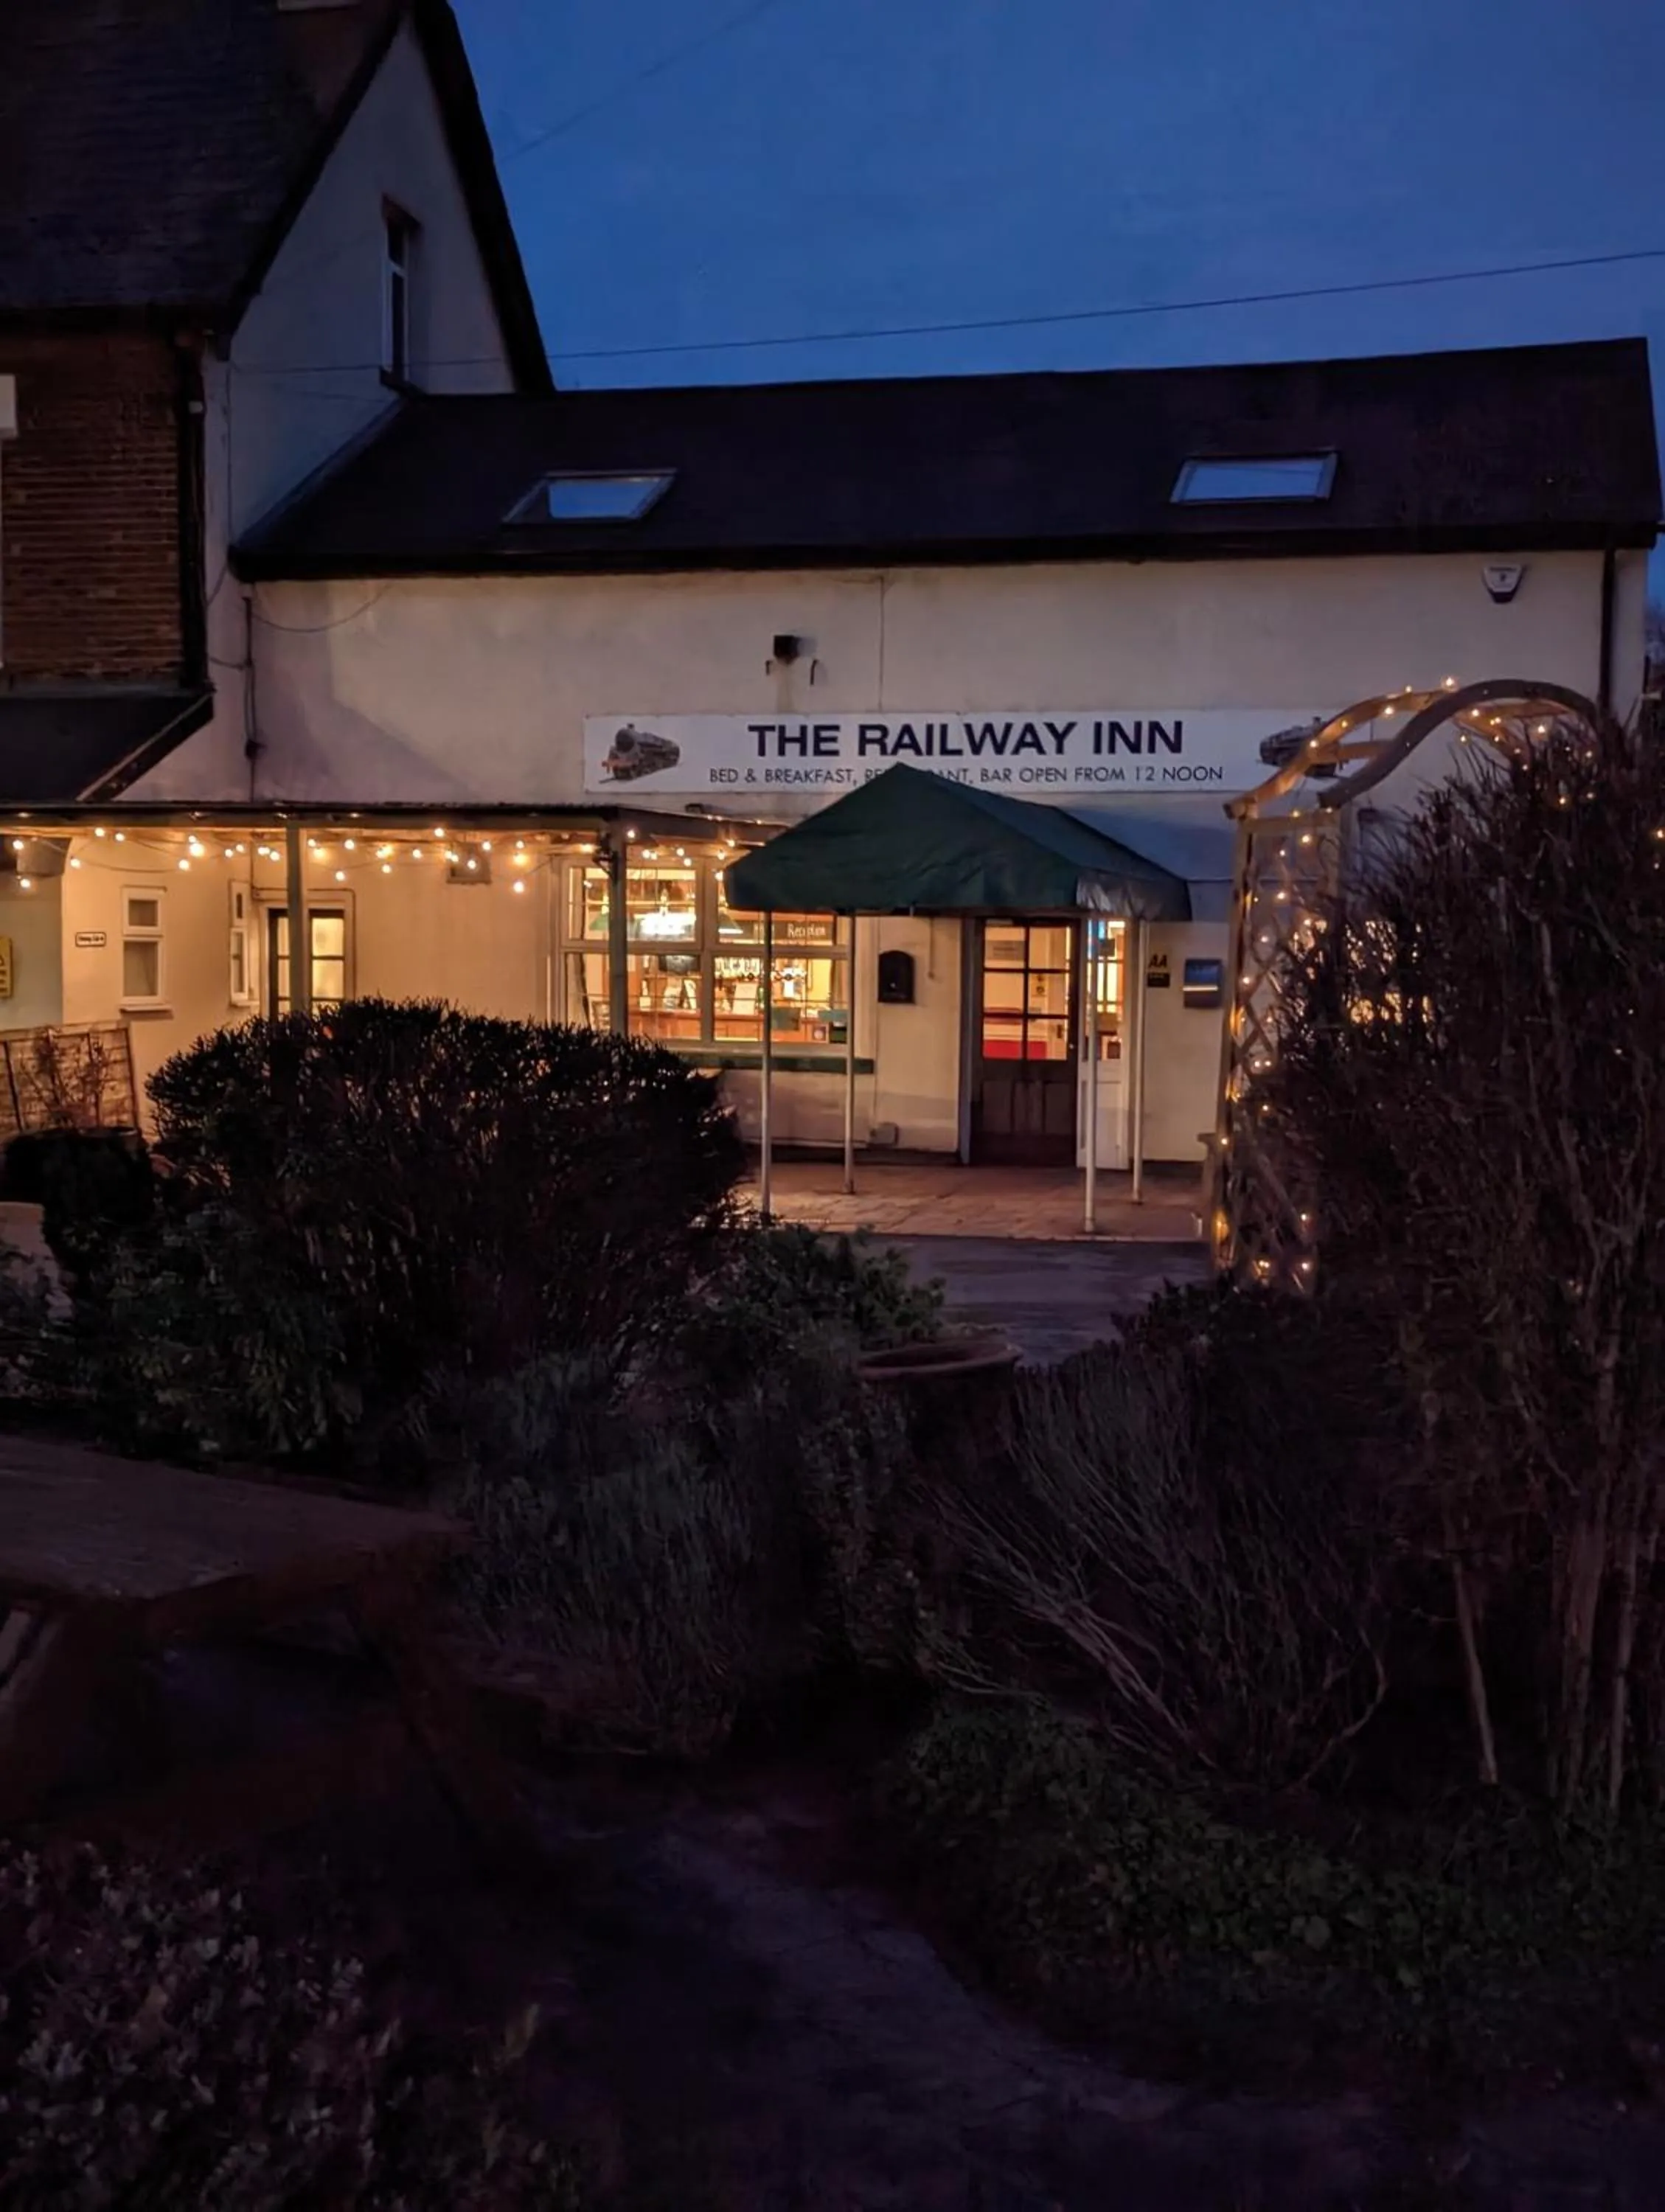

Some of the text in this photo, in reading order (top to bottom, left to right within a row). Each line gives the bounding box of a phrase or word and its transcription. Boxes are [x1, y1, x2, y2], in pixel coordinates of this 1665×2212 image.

[748, 720, 1183, 757] THE RAILWAY INN
[709, 768, 738, 783] BED
[744, 768, 757, 783] &
[765, 768, 858, 786] BREAKFAST,
[980, 767, 1012, 783] BAR
[1018, 767, 1067, 782] OPEN
[1074, 766, 1125, 782] FROM
[1136, 766, 1155, 781] 12
[1163, 765, 1223, 781] NOON
